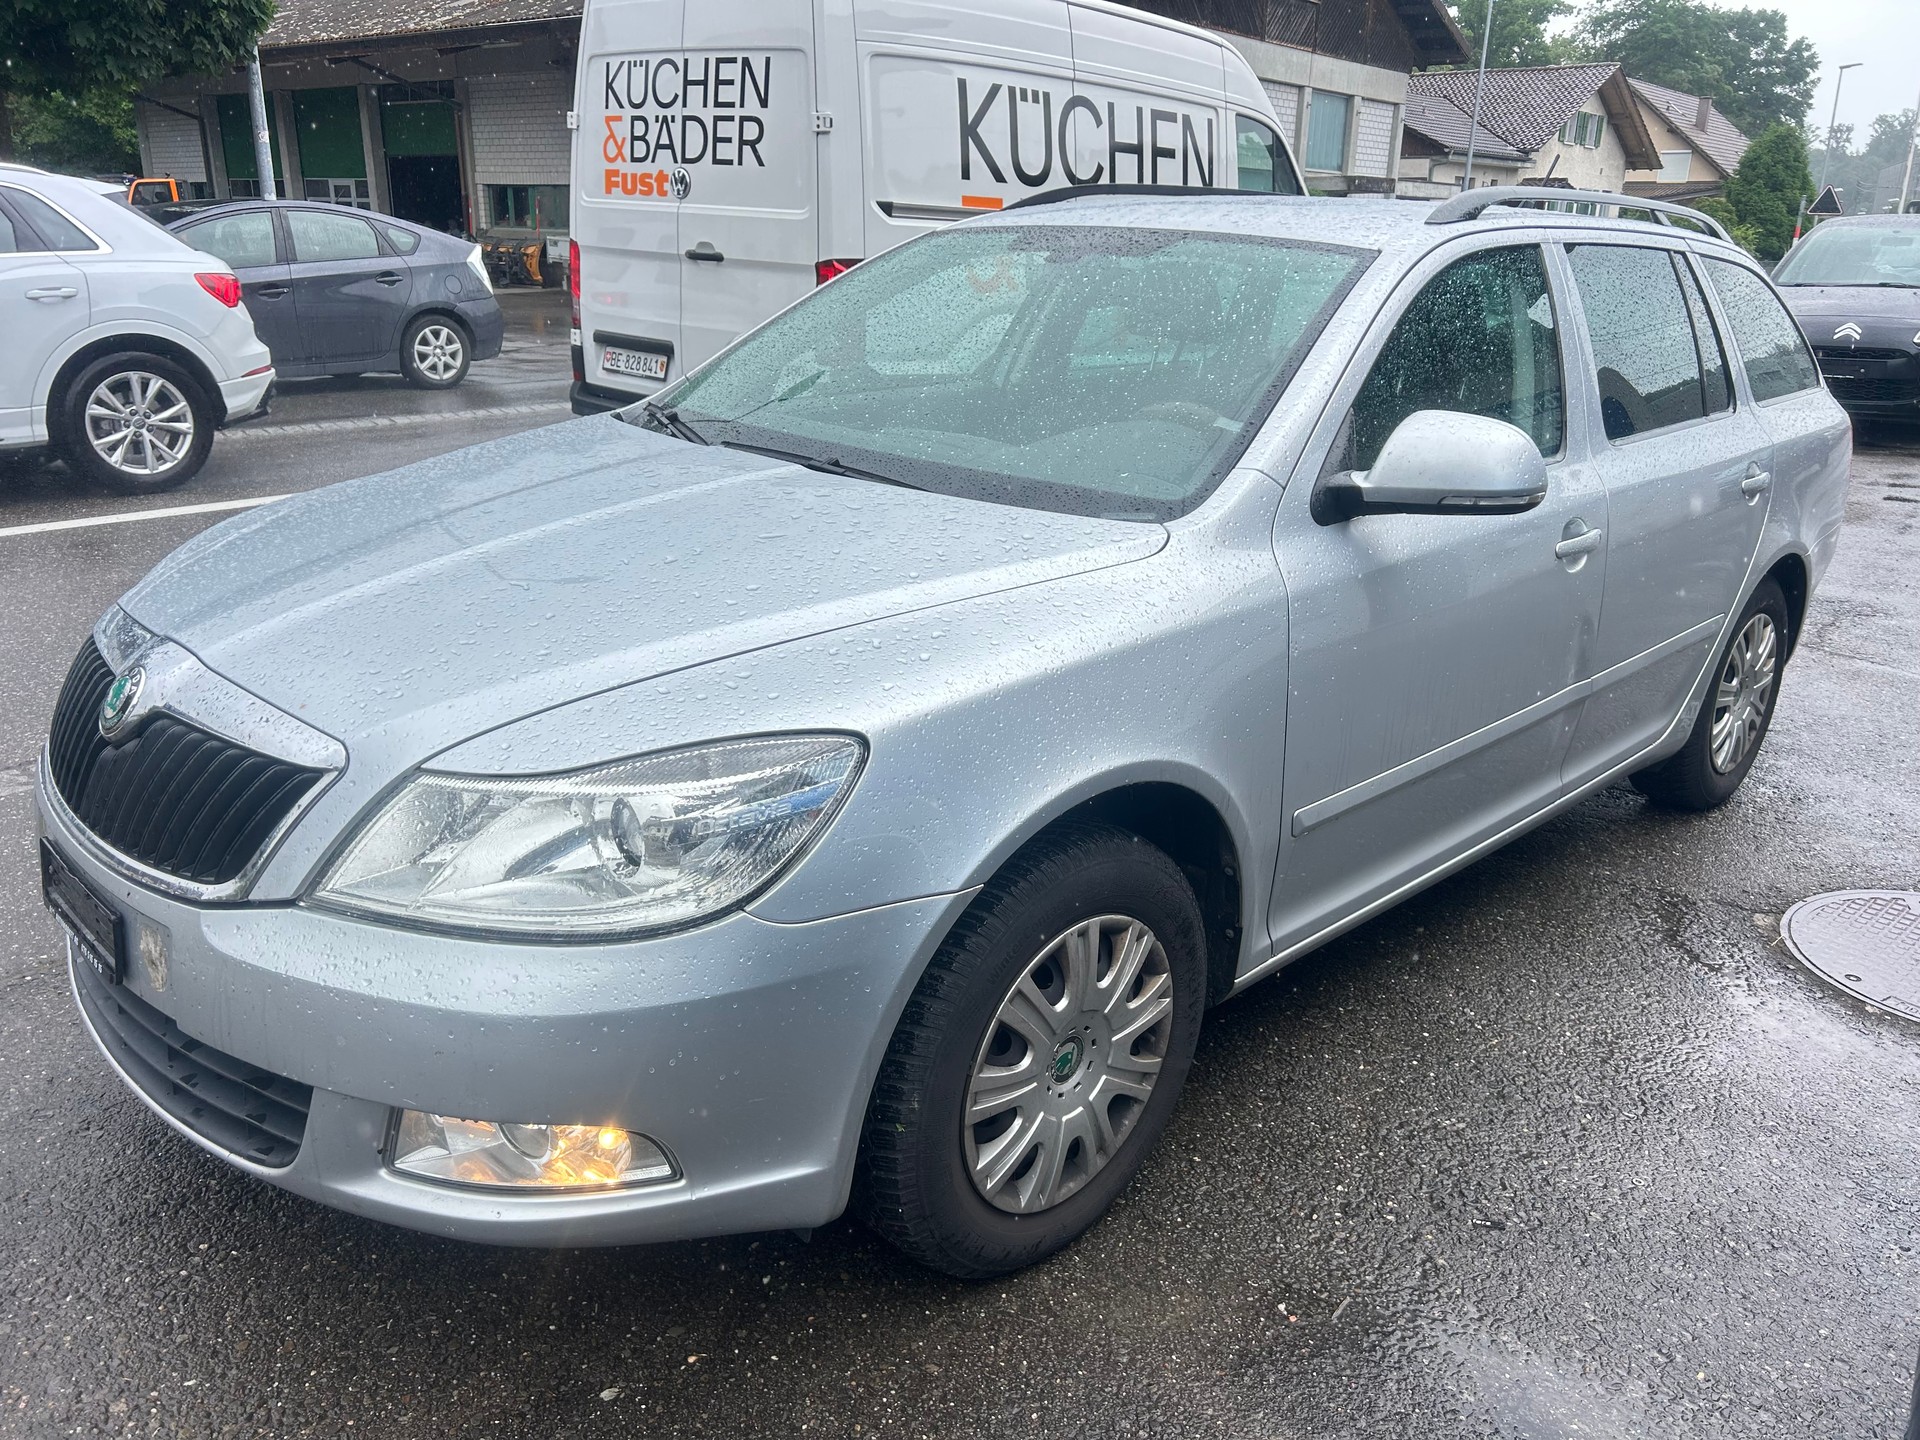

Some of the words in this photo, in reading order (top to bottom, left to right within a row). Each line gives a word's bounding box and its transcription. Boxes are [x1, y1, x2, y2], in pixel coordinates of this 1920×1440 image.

[604, 56, 771, 110] KÜCHEN
[957, 77, 1214, 188] KÜCHEN
[604, 168, 669, 197] Fust
